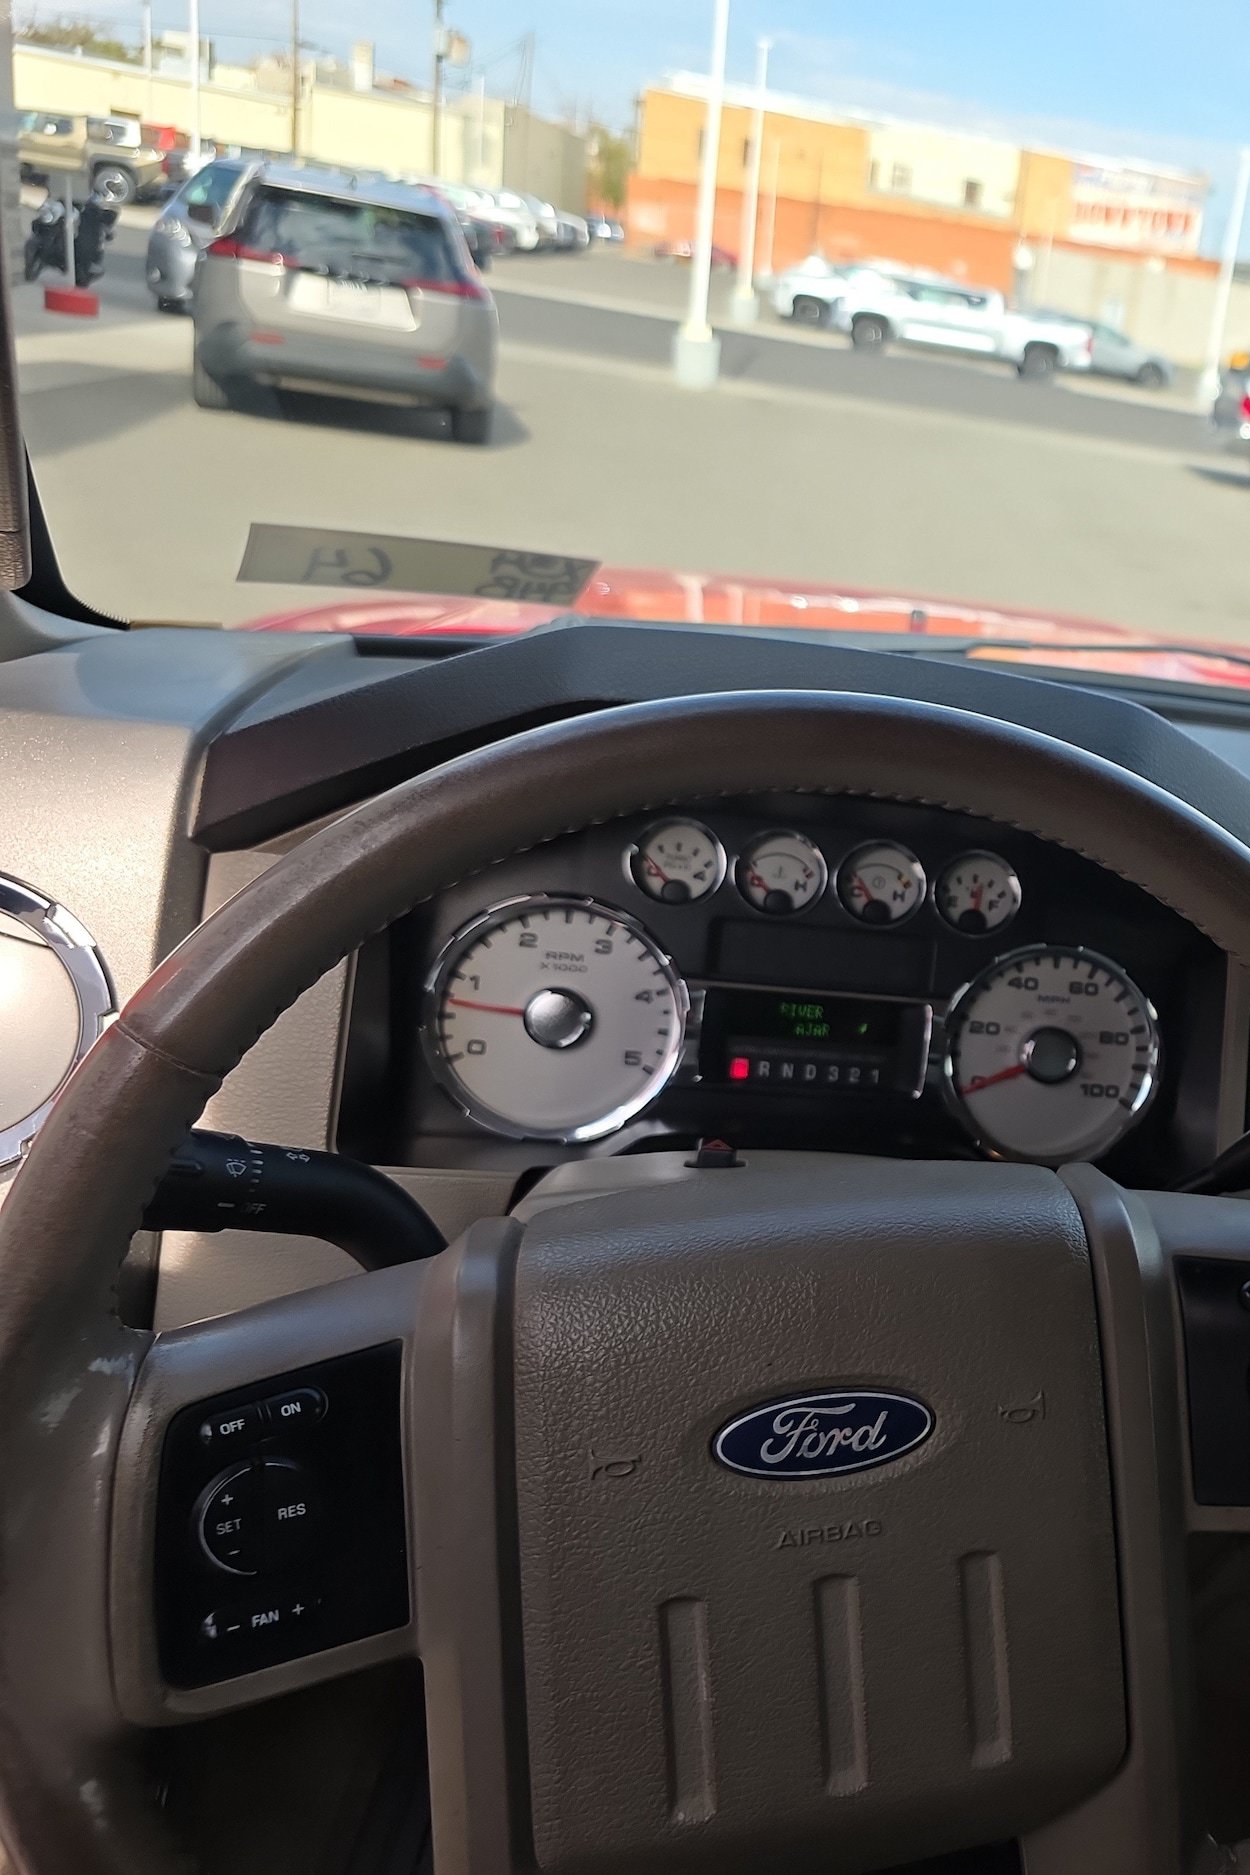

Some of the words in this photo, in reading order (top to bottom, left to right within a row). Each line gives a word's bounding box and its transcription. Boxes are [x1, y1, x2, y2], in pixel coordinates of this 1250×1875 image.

[519, 932, 538, 948] 2
[595, 939, 613, 955] 3
[545, 951, 585, 963] RPM
[470, 975, 481, 990] 1
[1008, 977, 1039, 991] 40
[1069, 981, 1099, 996] 60
[635, 989, 652, 1004] 4
[969, 1021, 1001, 1036] 20
[1099, 1031, 1130, 1046] 80
[467, 1039, 487, 1056] 0
[624, 1051, 642, 1066] 5
[758, 1060, 770, 1077] R
[782, 1063, 794, 1079] N
[805, 1064, 817, 1080] D
[828, 1066, 839, 1082] 3
[849, 1067, 861, 1084] 2
[871, 1069, 880, 1084] 1
[1080, 1083, 1120, 1098] 100
[280, 1401, 302, 1417] ON
[219, 1418, 246, 1436] OFF
[760, 1402, 889, 1465] Ford
[277, 1503, 307, 1521] RES
[215, 1518, 243, 1536] SET
[775, 1520, 882, 1549] AIRBAG
[251, 1609, 280, 1628] FAN
